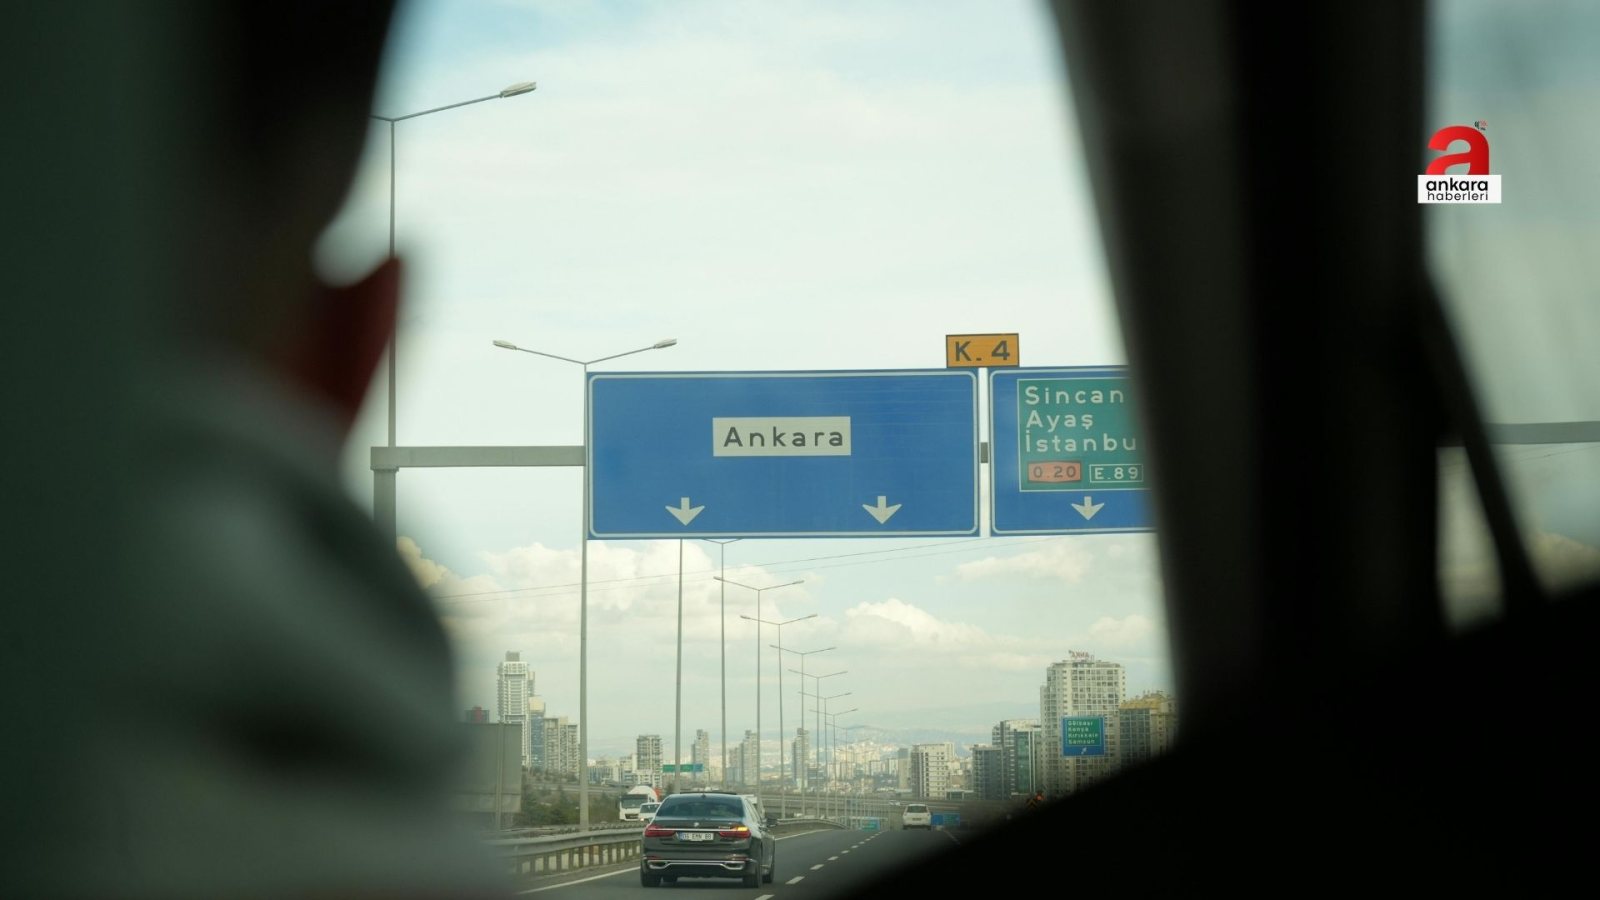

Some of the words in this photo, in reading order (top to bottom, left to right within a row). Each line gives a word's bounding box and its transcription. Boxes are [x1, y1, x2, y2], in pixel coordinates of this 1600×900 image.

[1025, 386, 1124, 405] Sincan
[1026, 410, 1093, 432] Ayaş
[723, 426, 843, 447] Ankara
[1026, 430, 1137, 452] İstanbu
[1094, 466, 1139, 480] E.89
